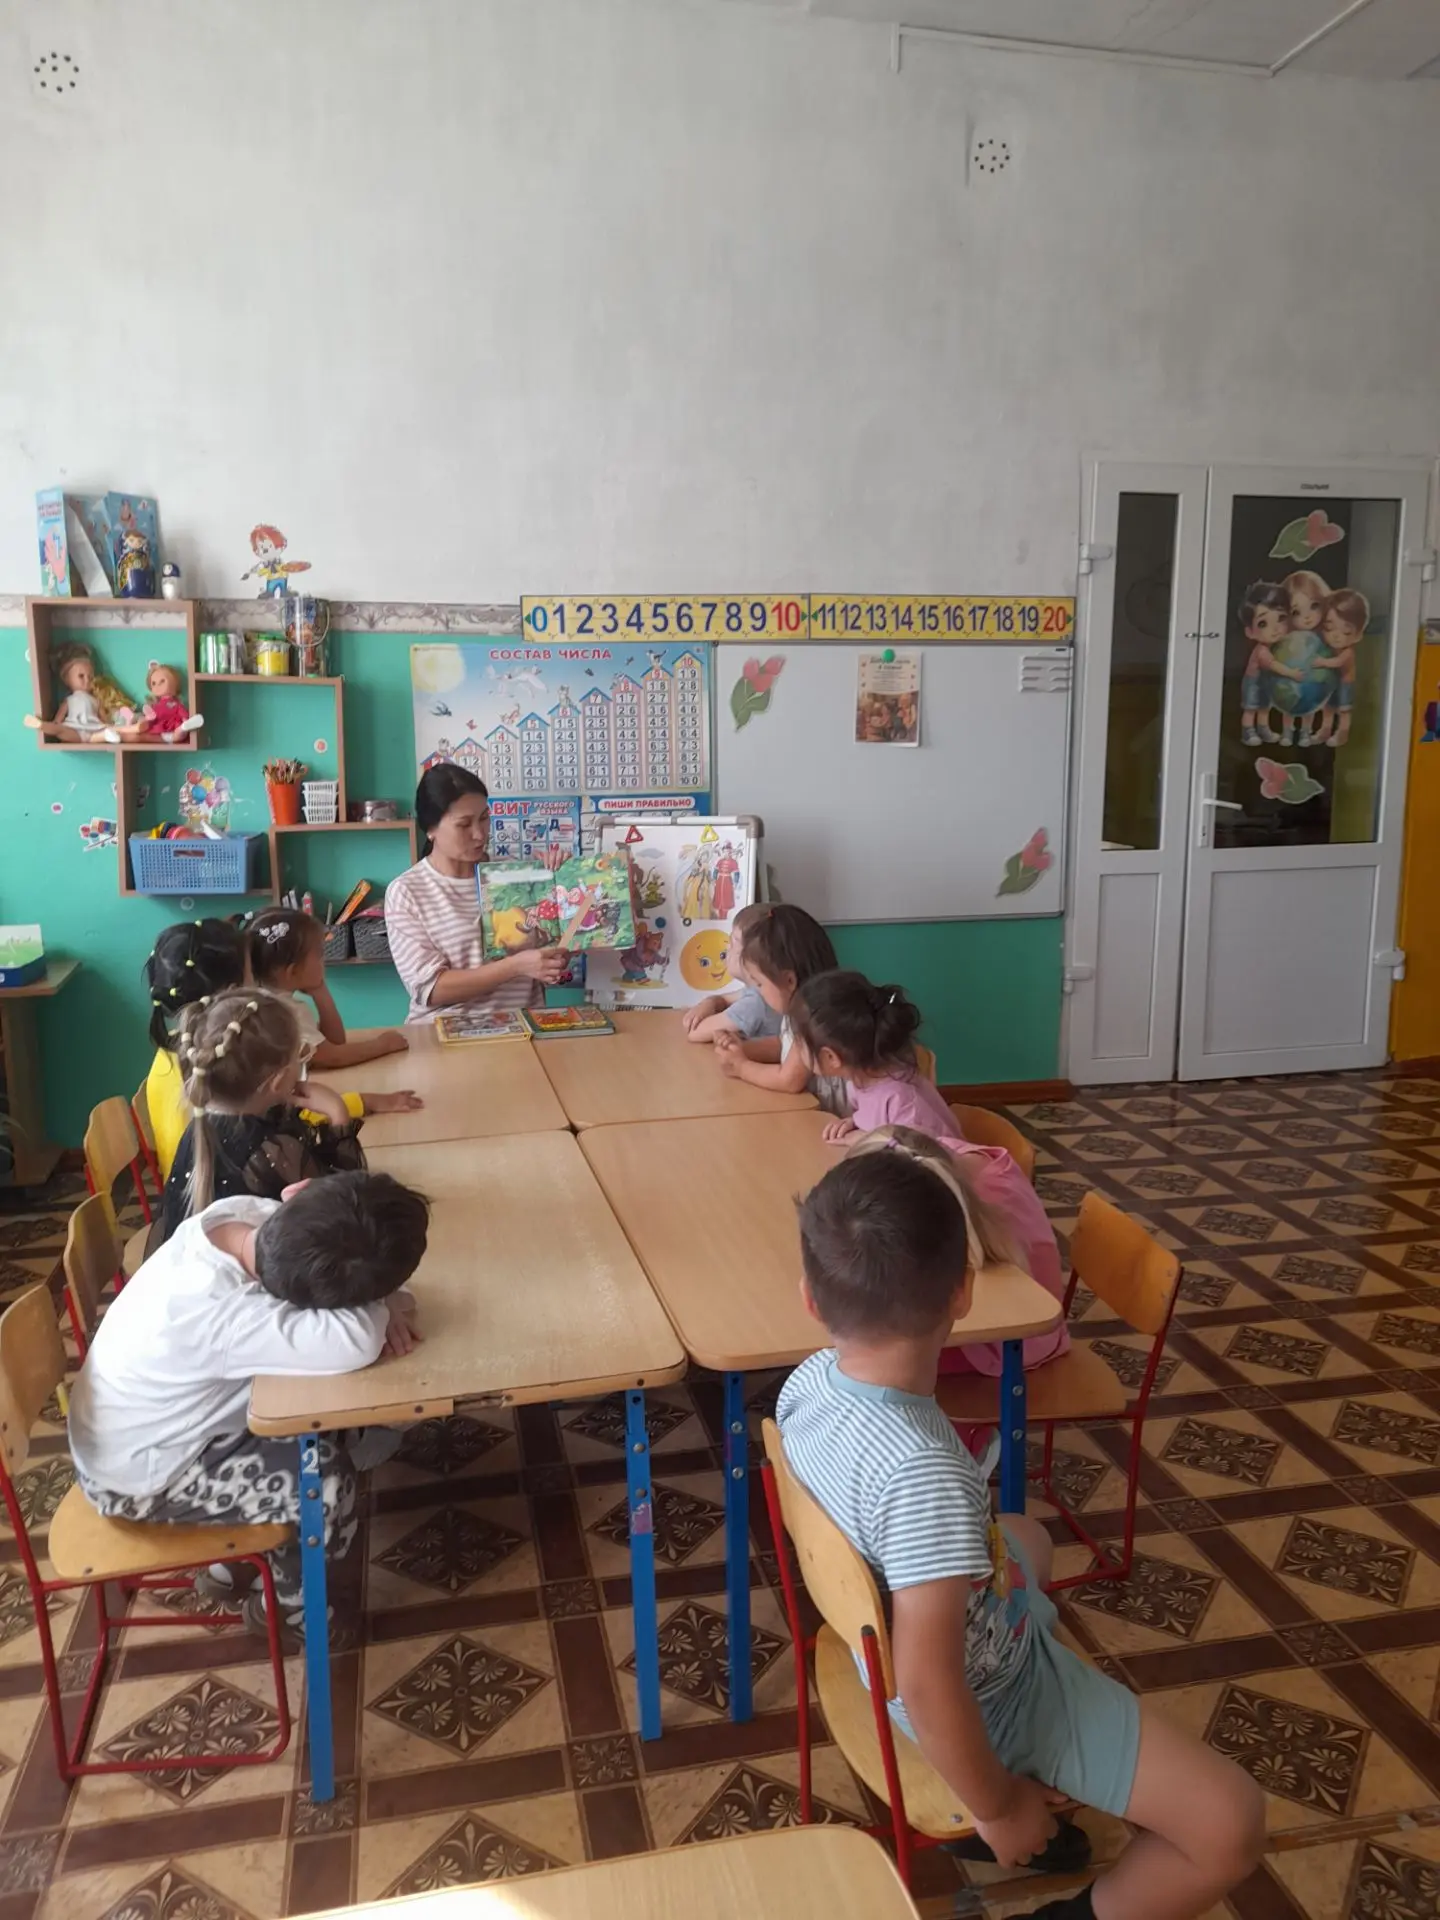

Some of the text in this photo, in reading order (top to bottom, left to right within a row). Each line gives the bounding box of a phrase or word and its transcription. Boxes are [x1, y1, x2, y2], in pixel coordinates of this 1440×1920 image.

[532, 602, 800, 634] 0 1 2 3 4 5 6 7 8 9 10
[818, 604, 1066, 632] 11 12 13 14 15 16 17 18 19 20
[490, 650, 612, 660] СОСТАВ ЧИСЛА
[690, 669, 696, 678] 9
[660, 681, 666, 690] 8
[680, 681, 696, 690] 2 8
[593, 694, 598, 703] 7
[629, 694, 635, 703] 7
[650, 693, 666, 702] 2 7
[680, 693, 696, 702] 3 7
[598, 706, 604, 715] 6
[619, 706, 635, 715] 2 6
[650, 705, 666, 714] 3 6
[681, 705, 697, 714] 4 6
[567, 718, 573, 727] 5
[588, 718, 605, 727] 2 5
[620, 718, 636, 727] 3 5
[650, 717, 666, 726] 4 5
[681, 717, 697, 726] 5 5
[536, 732, 541, 740] 4
[557, 731, 574, 740] 2 4
[588, 730, 605, 739] 3 4
[620, 730, 636, 739] 4 4
[650, 729, 666, 738] 5 4
[681, 729, 697, 738] 6 4
[504, 744, 510, 753] 3
[526, 744, 542, 752] 2 3
[557, 743, 574, 752] 3 3
[589, 742, 605, 751] 4 3
[620, 742, 636, 751] 5 3
[650, 740, 667, 749] 6 3
[681, 741, 697, 750] 7 3
[494, 756, 511, 765] 2 2
[526, 756, 543, 765] 3 2
[558, 755, 575, 764] 4 2
[589, 754, 606, 763] 5 2
[620, 754, 637, 763] 6 2
[651, 753, 667, 762] 7 2
[682, 753, 698, 762] 8 2
[494, 768, 500, 777] 3
[527, 768, 533, 777] 4
[558, 767, 564, 776] 5
[589, 766, 595, 775] 6
[620, 766, 626, 775] 7
[651, 765, 657, 774] 8
[682, 764, 688, 773] 9
[495, 780, 512, 789] 4 0
[528, 780, 544, 789] 5 0
[558, 779, 576, 788] 6 0
[590, 778, 606, 786] 7 0
[620, 777, 637, 786] 8 0
[651, 777, 668, 786] 9 0
[680, 776, 698, 785] 10 0
[604, 798, 692, 808] ПИШИ ПРАВИЛЬНО
[496, 820, 504, 830] В
[550, 818, 560, 831] Д
[496, 845, 510, 856] Ж
[302, 1448, 318, 1474] 2
